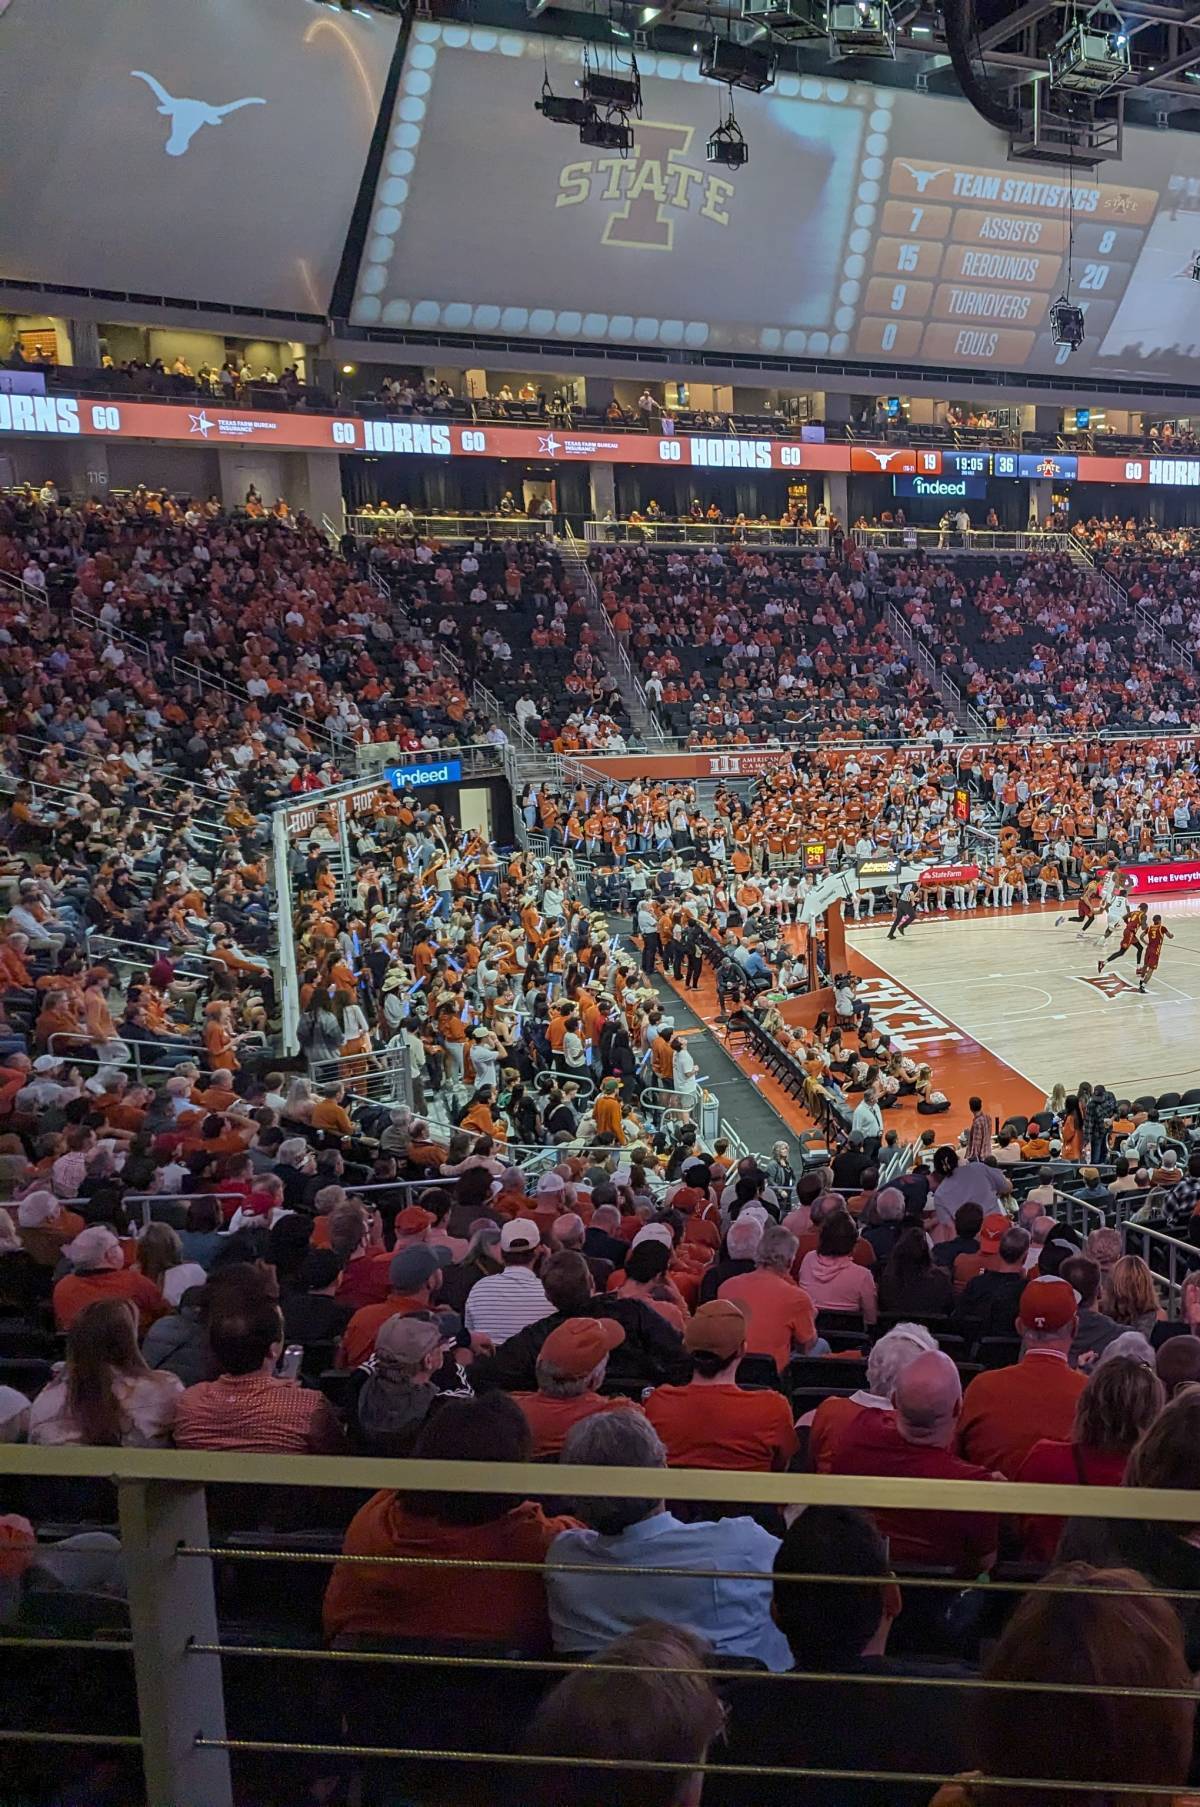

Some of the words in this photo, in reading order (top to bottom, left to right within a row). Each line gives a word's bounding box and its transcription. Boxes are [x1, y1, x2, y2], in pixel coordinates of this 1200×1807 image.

[554, 159, 735, 226] STATE
[952, 173, 999, 201] TEAM
[999, 180, 1101, 213] STATISTICS
[911, 208, 924, 233] 7
[979, 216, 1042, 245] ASSISTS
[1099, 230, 1116, 254] 8
[896, 244, 920, 272] 15
[960, 251, 1040, 282] REBOUNDS
[1079, 264, 1109, 290] 20
[890, 283, 906, 311] 9
[947, 289, 1031, 321] TURNOVERS
[882, 323, 898, 351] 0
[953, 329, 998, 358] FOULS
[91, 406, 121, 431] GO
[332, 422, 355, 444] GO
[461, 431, 485, 452] GO
[659, 441, 680, 461] GO
[690, 438, 772, 469] HORNS
[781, 446, 800, 466] GO
[923, 453, 936, 470] 19
[955, 457, 983, 472] 19:05
[999, 457, 1014, 474] 36
[1036, 463, 1061, 474] STATE
[1125, 463, 1143, 480] GO
[87, 471, 108, 485] 116
[912, 476, 966, 496] indeed
[391, 767, 448, 786] indeed
[807, 845, 823, 854] 19:05
[807, 855, 821, 864] 29
[931, 871, 946, 880] State
[946, 870, 962, 879] Farm
[1147, 873, 1167, 884] Here
[854, 977, 965, 1052] TEXAS
[1034, 1317, 1046, 1329] T
